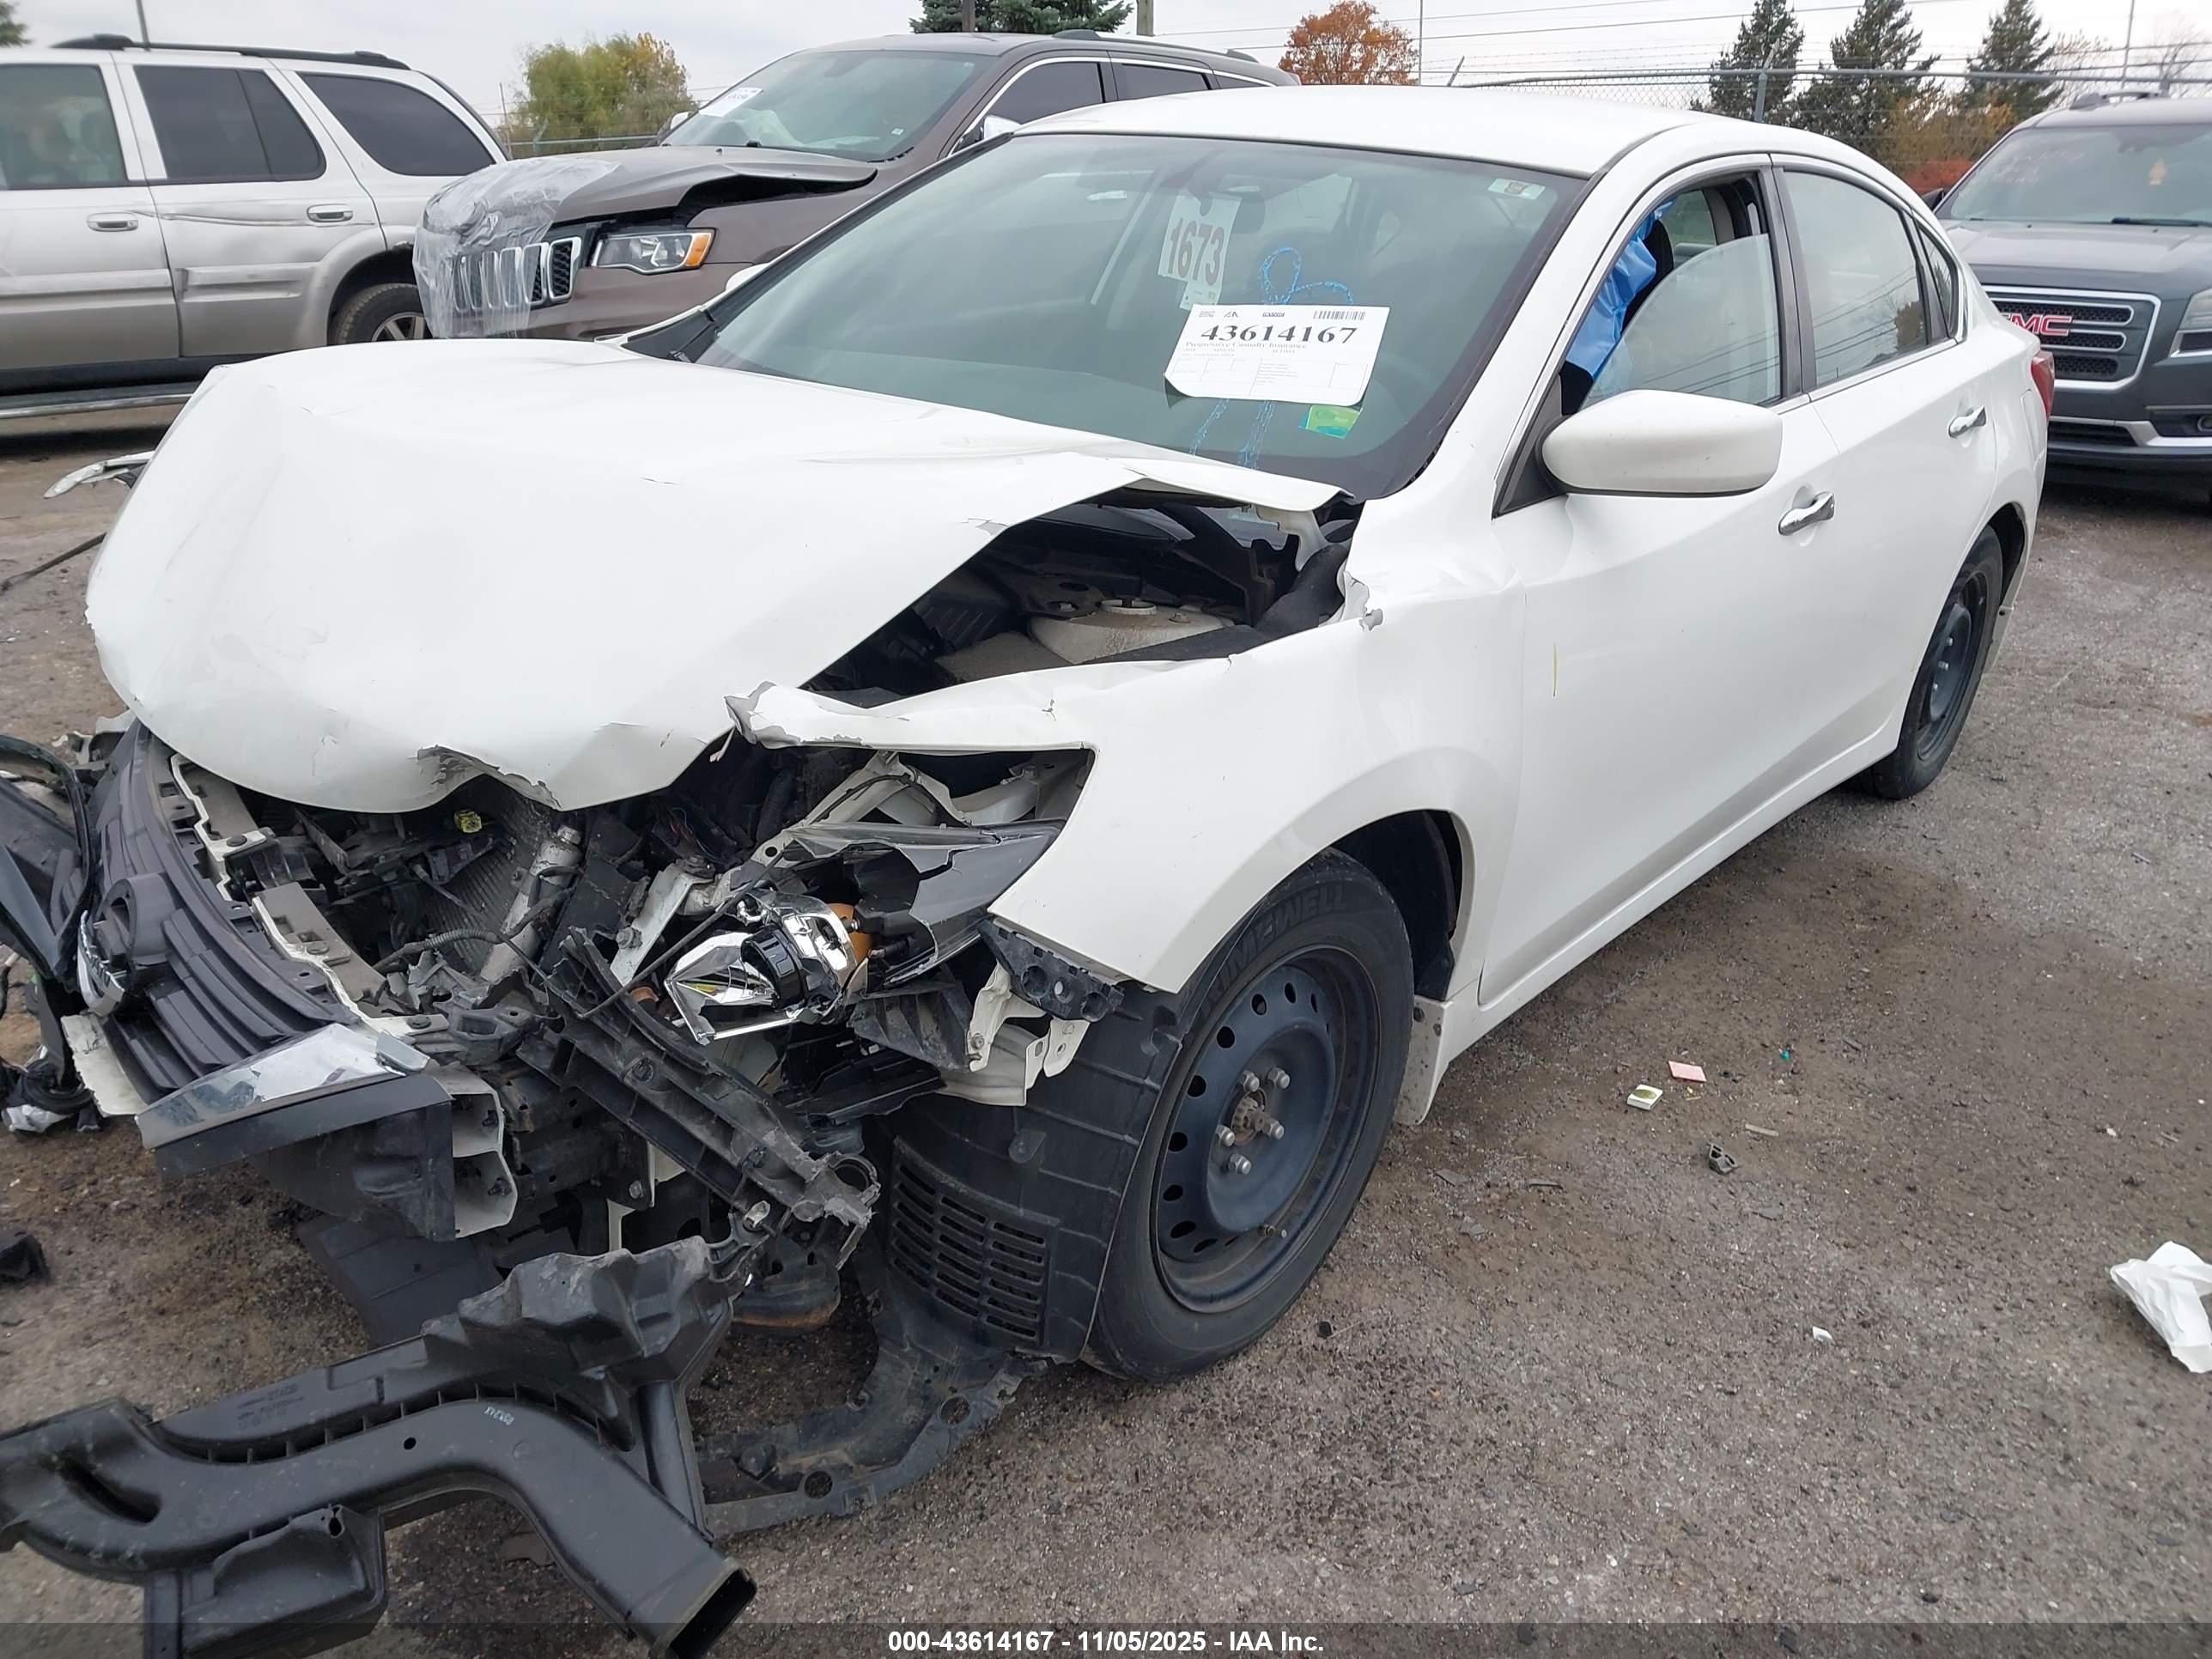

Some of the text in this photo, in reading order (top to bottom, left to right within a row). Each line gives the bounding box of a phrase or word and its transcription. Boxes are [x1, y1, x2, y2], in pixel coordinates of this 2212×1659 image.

[1168, 217, 1224, 286] 1673
[1200, 324, 1358, 344] 43614167
[2000, 312, 2073, 337] MC
